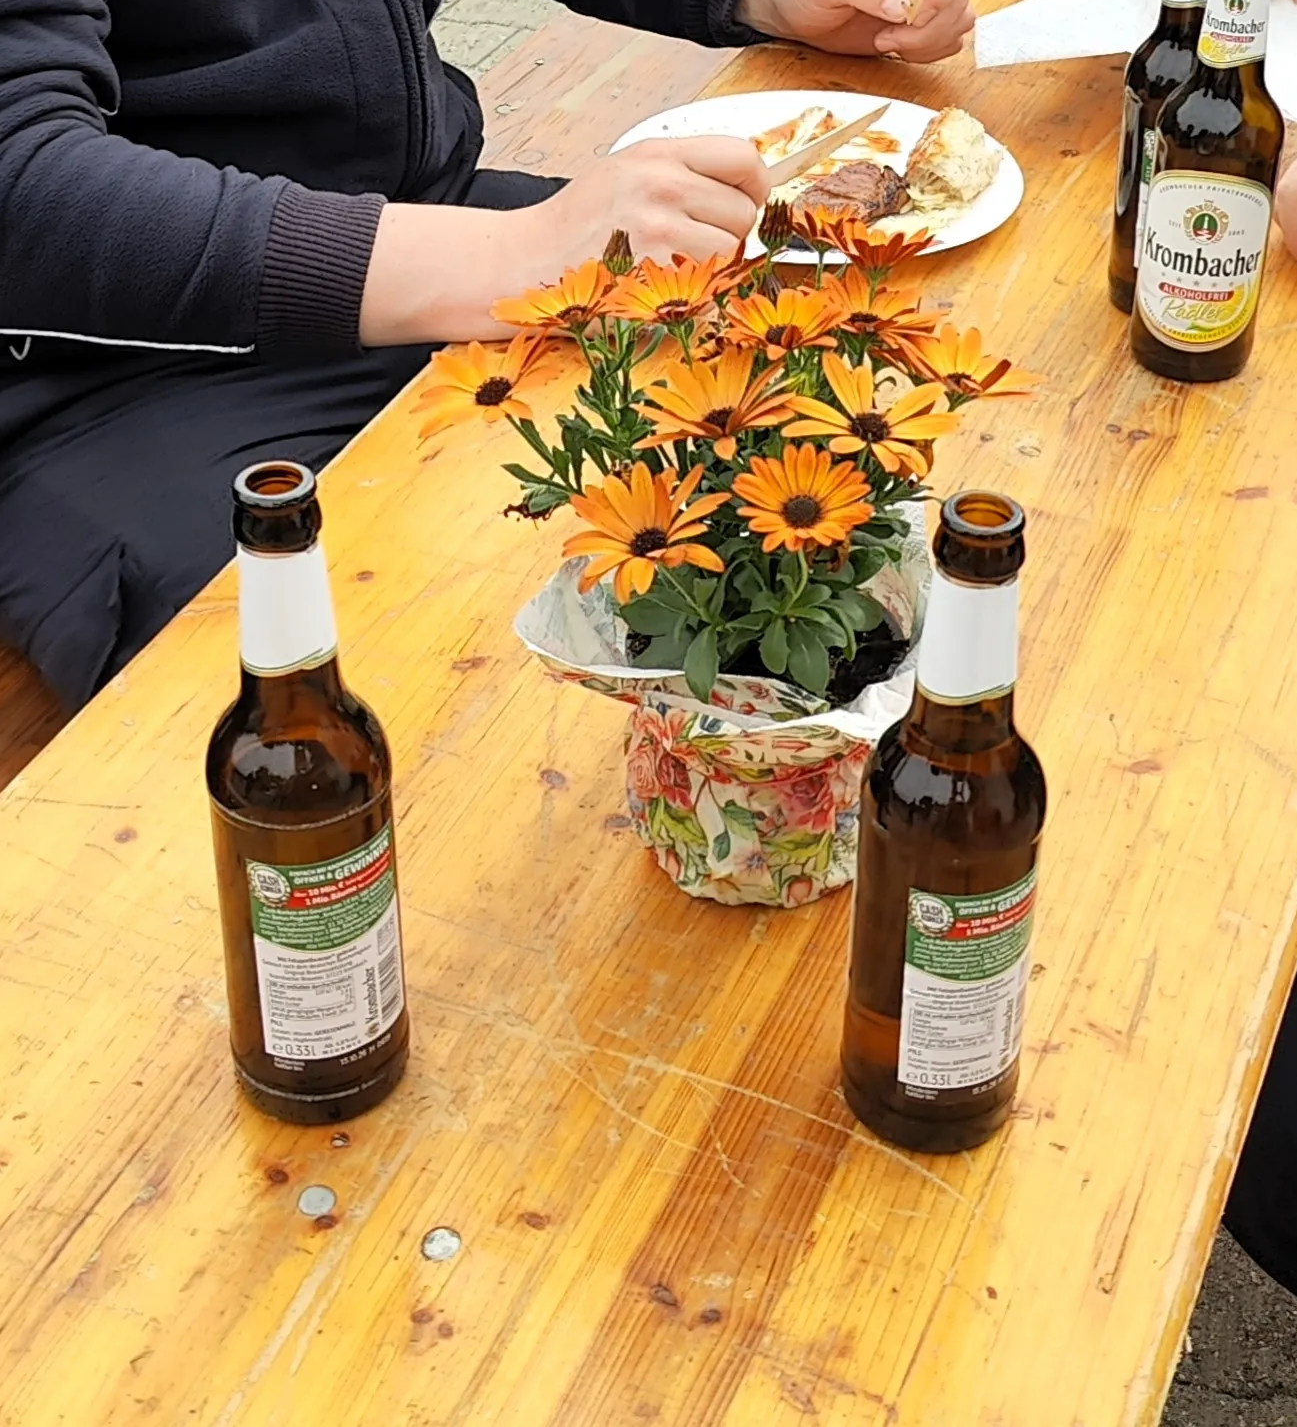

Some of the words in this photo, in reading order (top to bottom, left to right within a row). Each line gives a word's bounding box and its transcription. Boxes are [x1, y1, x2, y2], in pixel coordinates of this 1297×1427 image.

[1205, 12, 1266, 35] Krombacher
[1144, 226, 1262, 278] Krombacher
[1162, 285, 1229, 301] ALKOHOLFREI
[1160, 296, 1227, 323] Radler
[293, 874, 326, 885] ÖFFNEN
[334, 838, 390, 880] GEWINNEN
[308, 887, 320, 897] 10
[363, 966, 380, 1025] Krombacher
